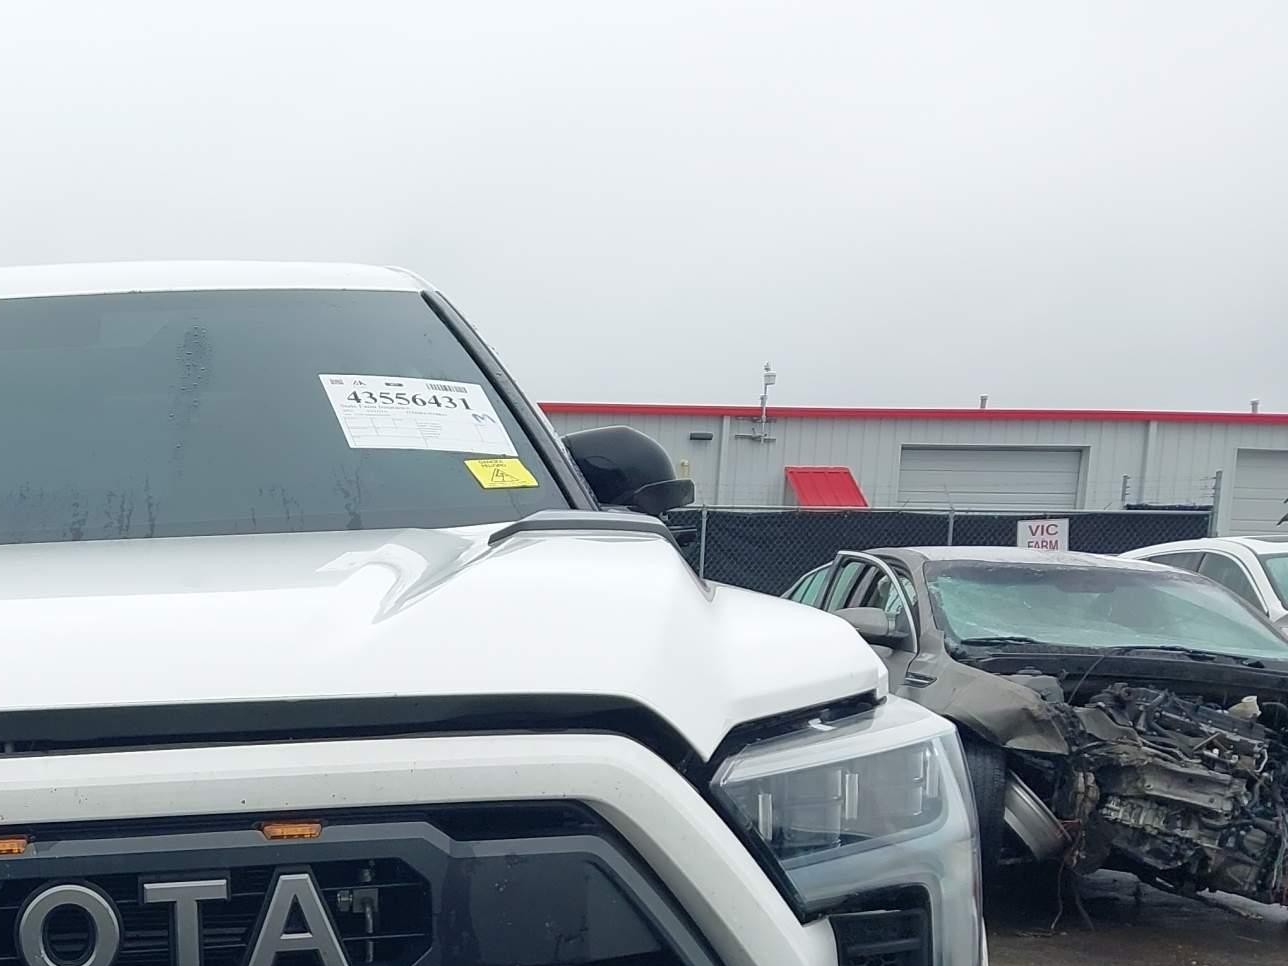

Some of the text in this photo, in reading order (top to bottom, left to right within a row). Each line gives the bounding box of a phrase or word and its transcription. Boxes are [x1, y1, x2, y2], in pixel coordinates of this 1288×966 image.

[346, 390, 473, 411] 43556431
[1028, 523, 1058, 537] VIC
[1027, 539, 1059, 550] FARM
